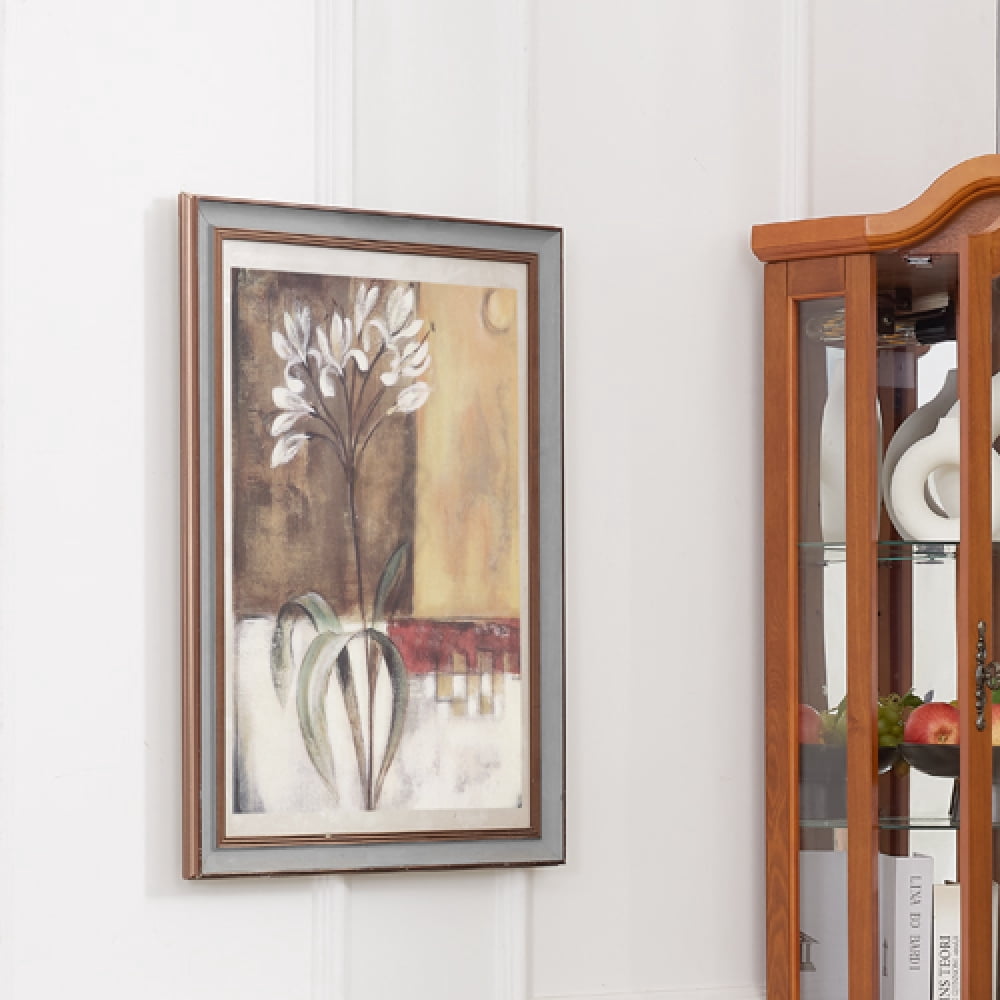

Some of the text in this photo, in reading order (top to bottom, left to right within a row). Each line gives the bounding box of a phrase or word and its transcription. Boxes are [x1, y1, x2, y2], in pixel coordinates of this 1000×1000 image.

[909, 875, 921, 905] LINA
[909, 912, 921, 929] BO
[938, 935, 951, 977] TEORI
